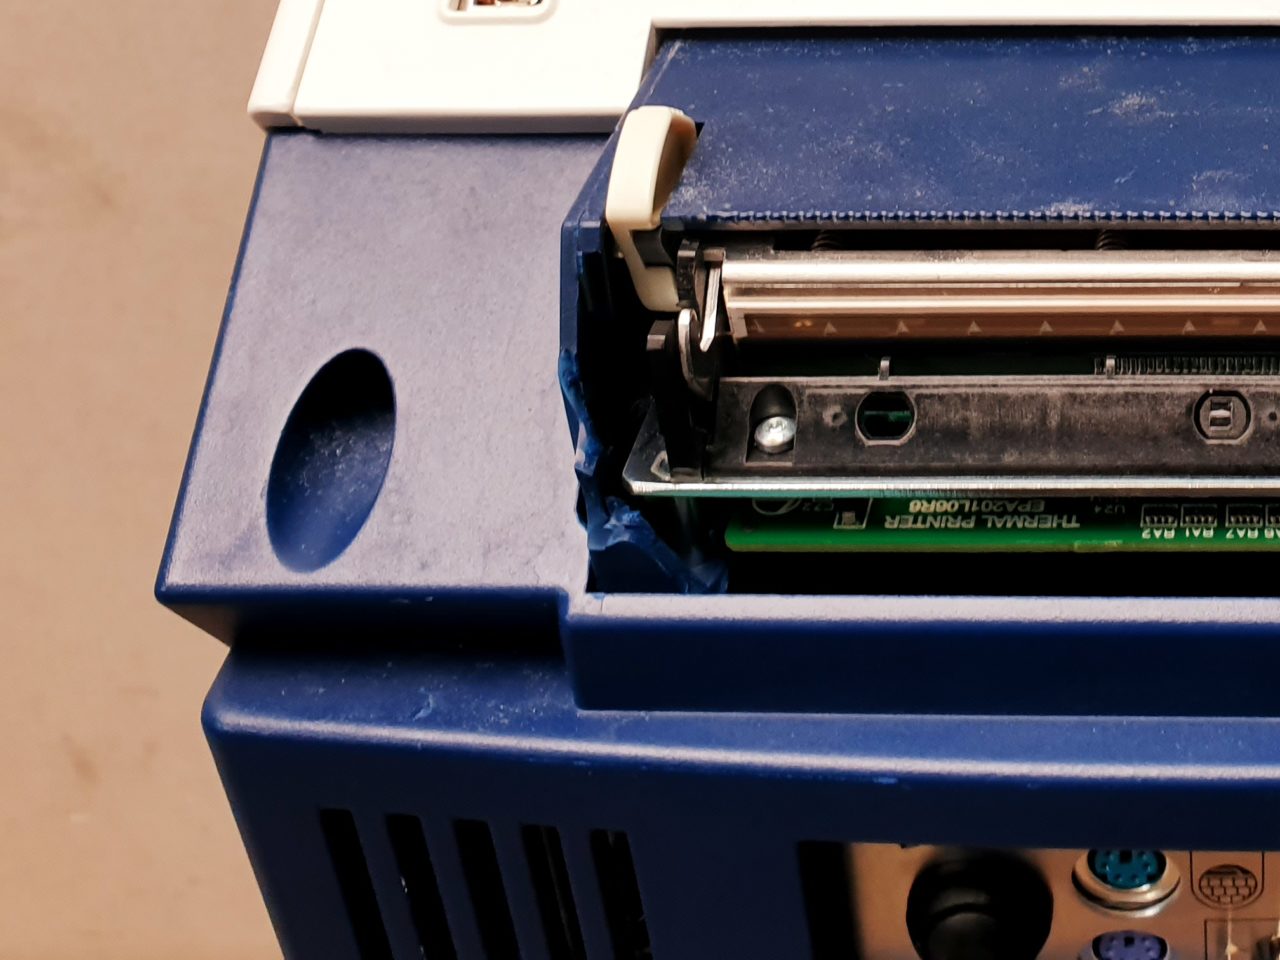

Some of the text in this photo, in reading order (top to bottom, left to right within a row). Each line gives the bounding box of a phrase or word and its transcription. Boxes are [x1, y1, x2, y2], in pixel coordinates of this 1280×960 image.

[883, 514, 1081, 529] THERMAL PRINTER
[1141, 527, 1176, 539] RA2
[1184, 527, 1215, 539] RA1
[1224, 527, 1260, 539] RA7
